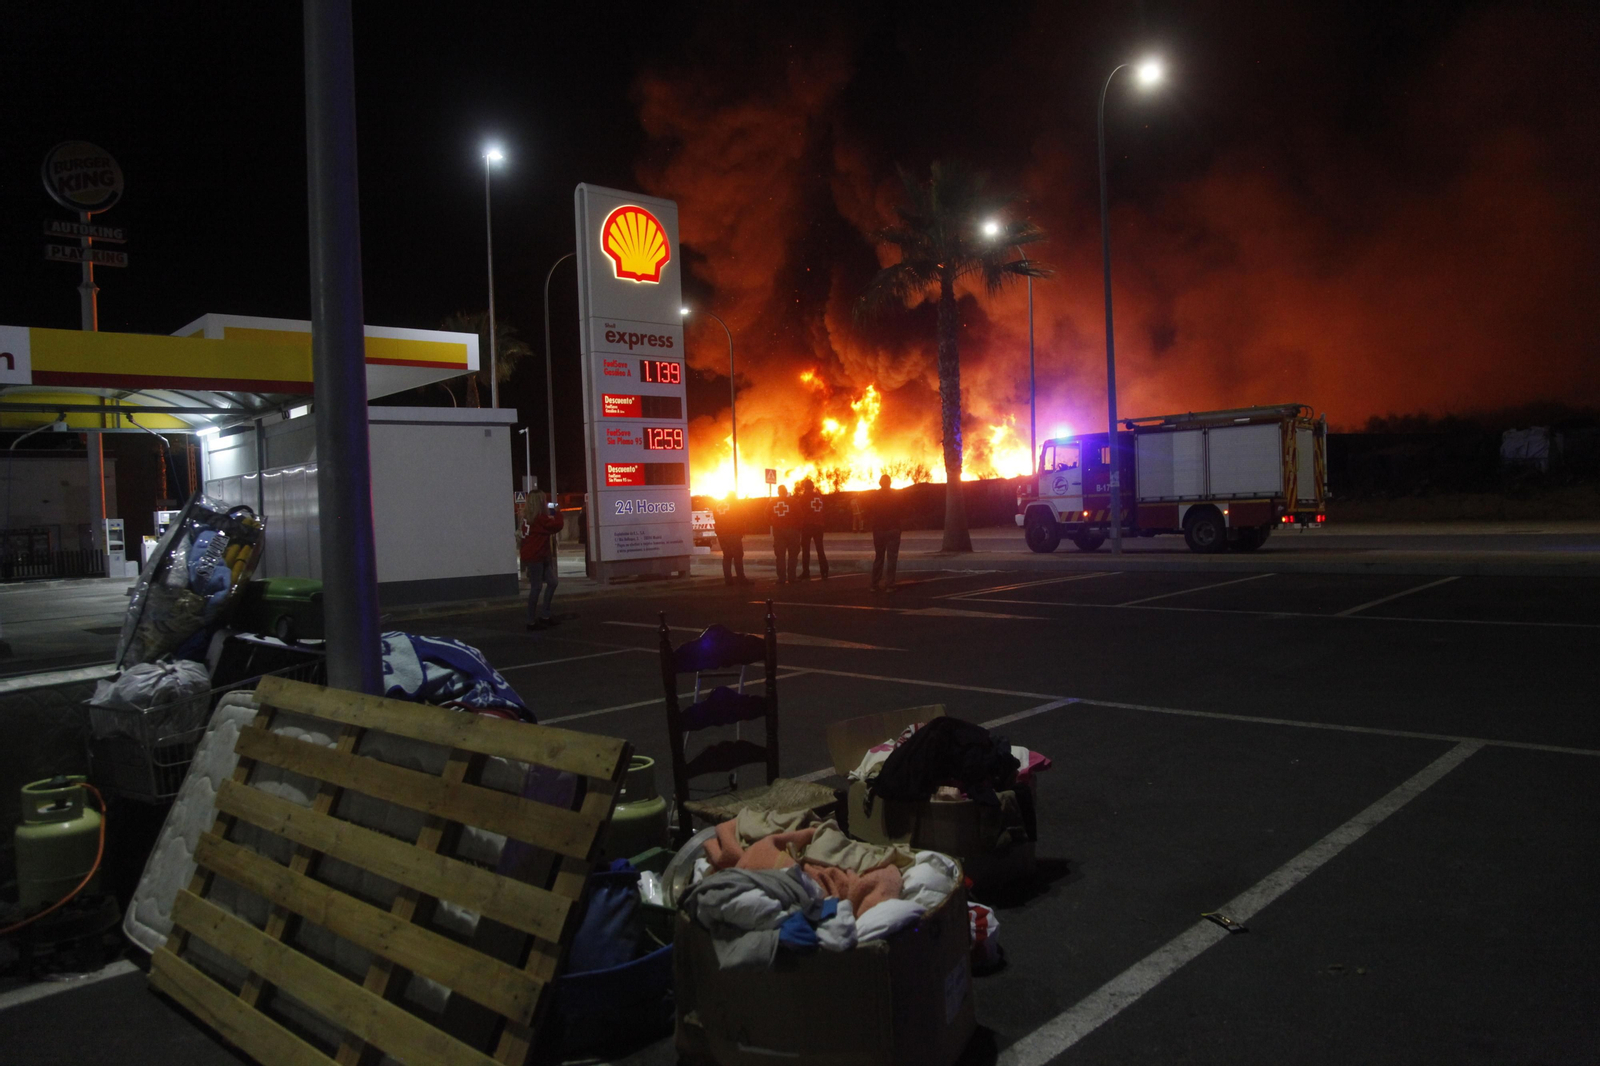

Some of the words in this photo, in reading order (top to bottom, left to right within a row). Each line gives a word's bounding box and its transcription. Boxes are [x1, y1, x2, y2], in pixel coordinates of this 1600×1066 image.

[54, 157, 110, 174] BURGER
[58, 170, 114, 194] KING
[52, 221, 123, 239] AUTOKING
[52, 246, 84, 258] PLAY
[92, 251, 124, 263] KING
[605, 330, 674, 350] express
[627, 369, 632, 377] A
[644, 360, 681, 384] 1.139
[635, 437, 643, 445] 95
[647, 428, 684, 449] 1.259
[615, 500, 633, 514] 24
[636, 500, 675, 513] Horas
